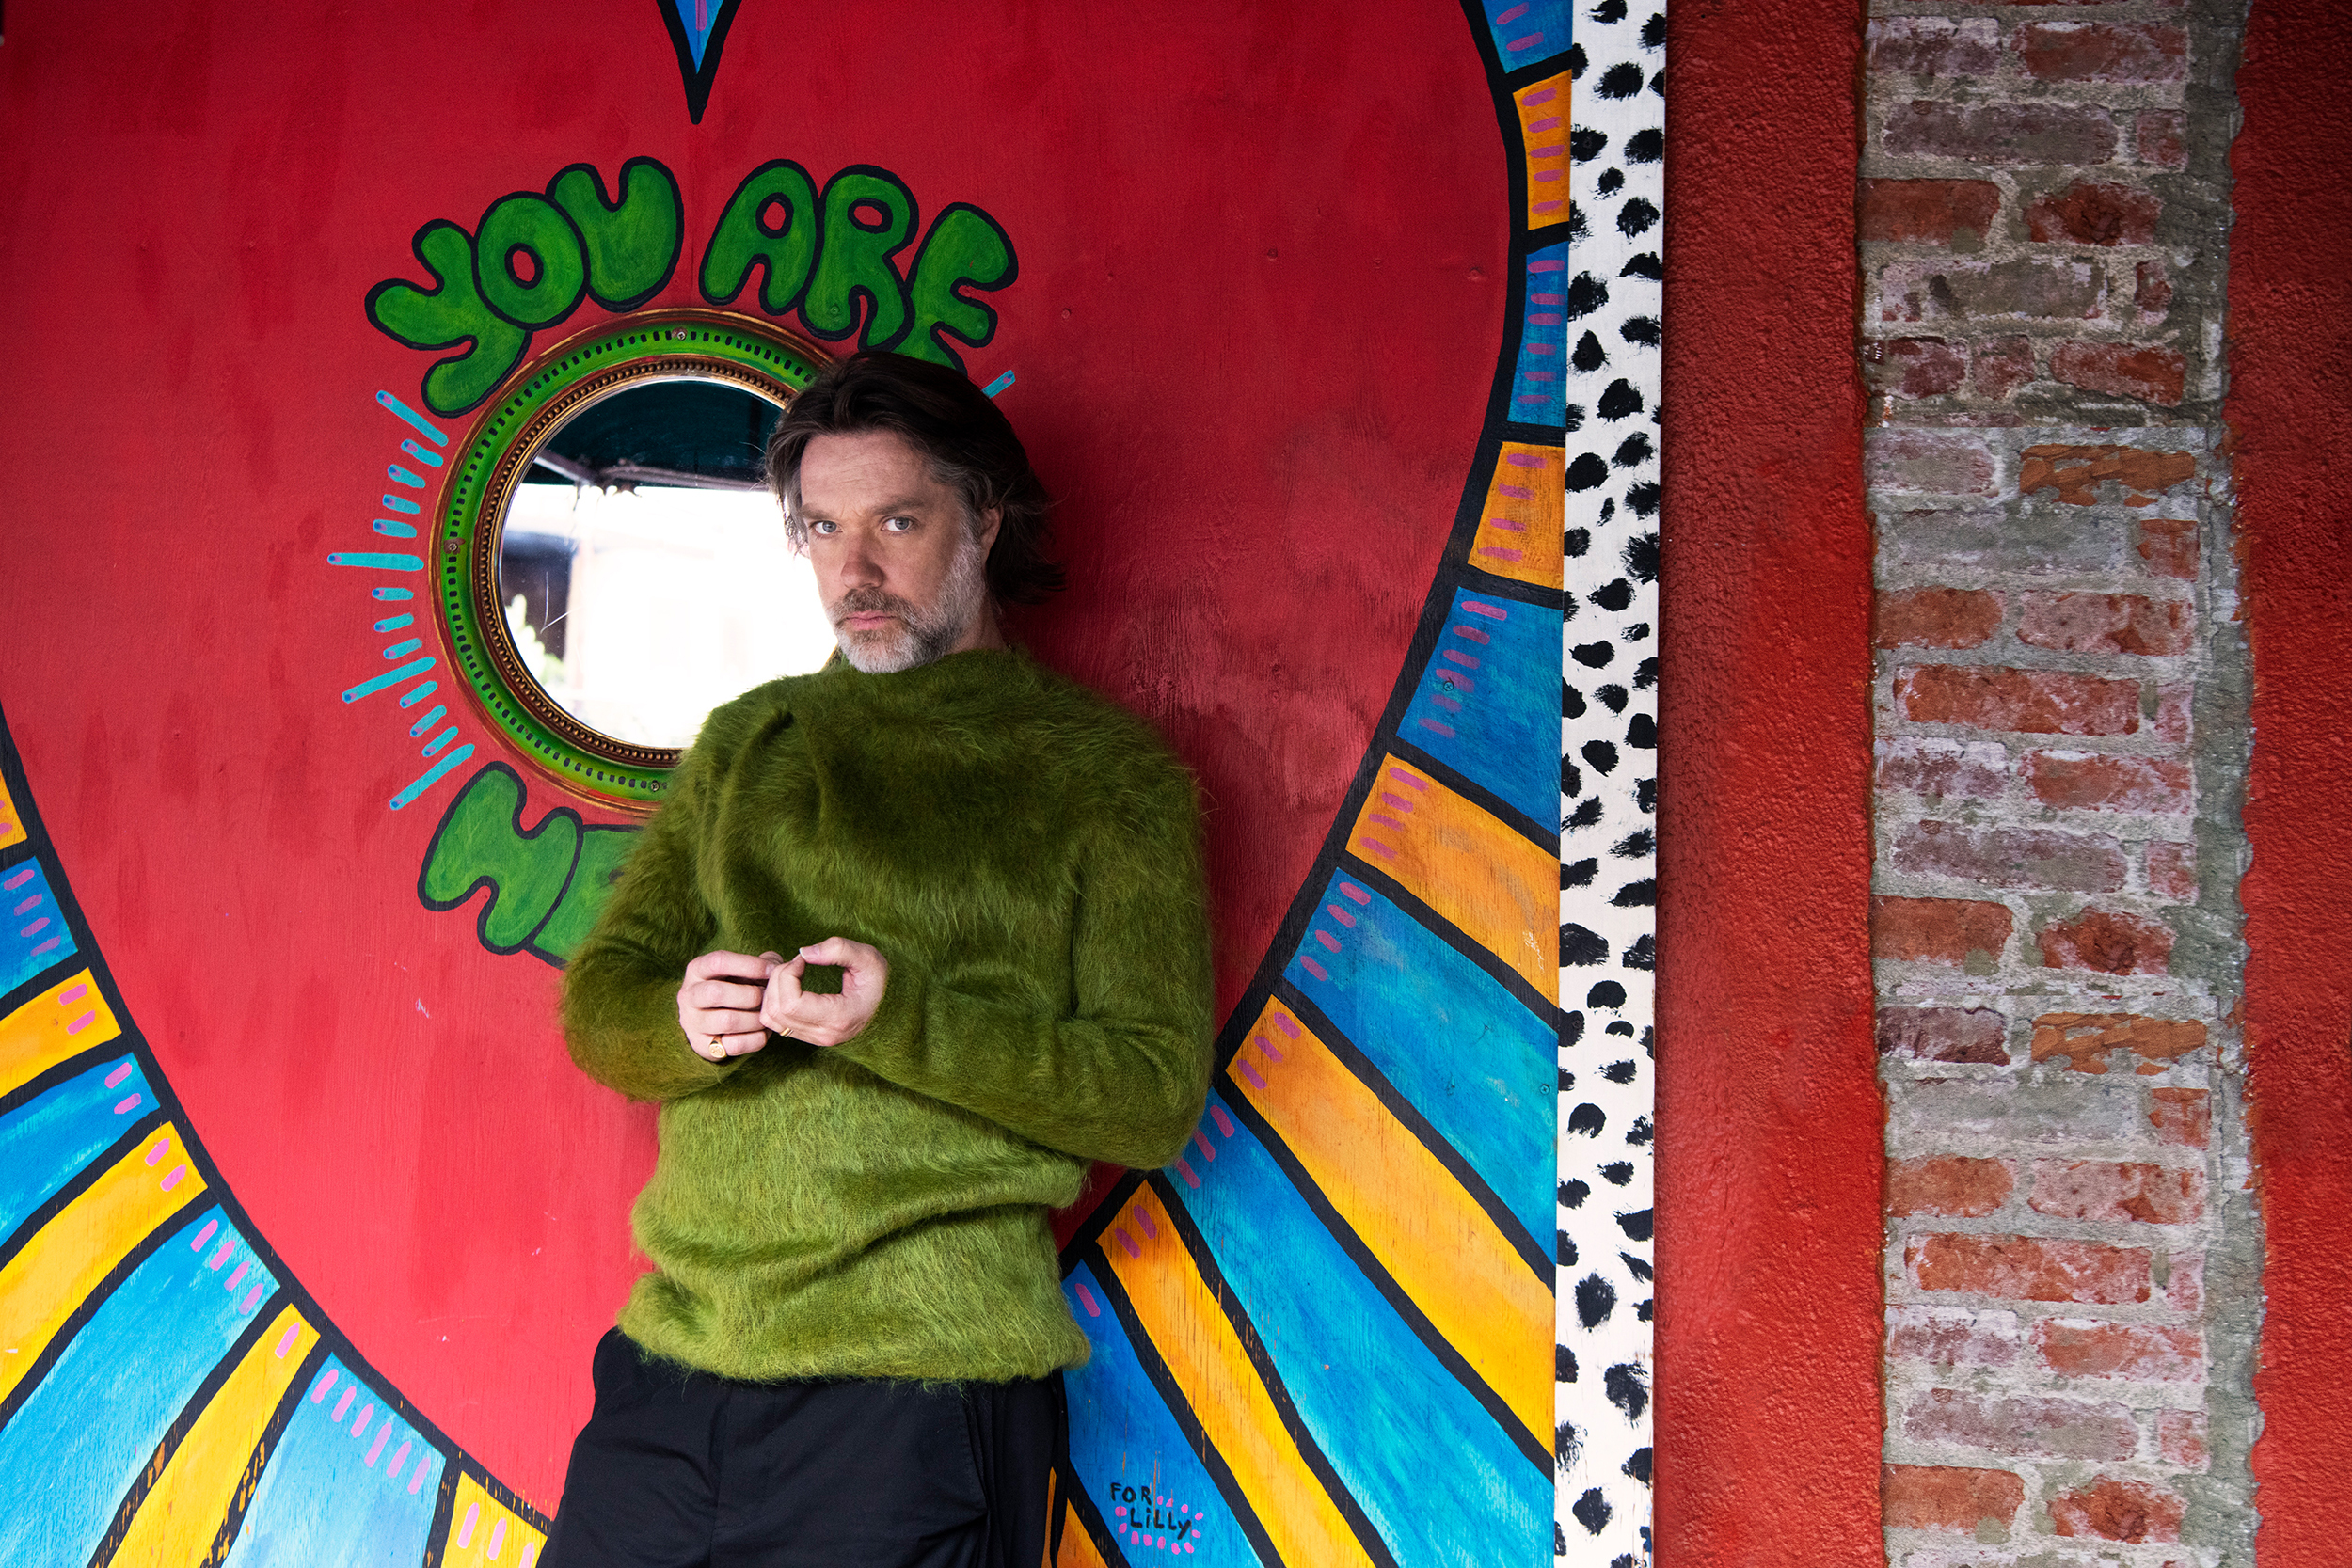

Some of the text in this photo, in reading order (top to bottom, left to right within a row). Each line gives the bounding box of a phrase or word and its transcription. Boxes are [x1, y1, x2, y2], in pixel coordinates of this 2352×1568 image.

[364, 156, 1020, 418] YOU ARE
[1110, 1482, 1152, 1506] FOR
